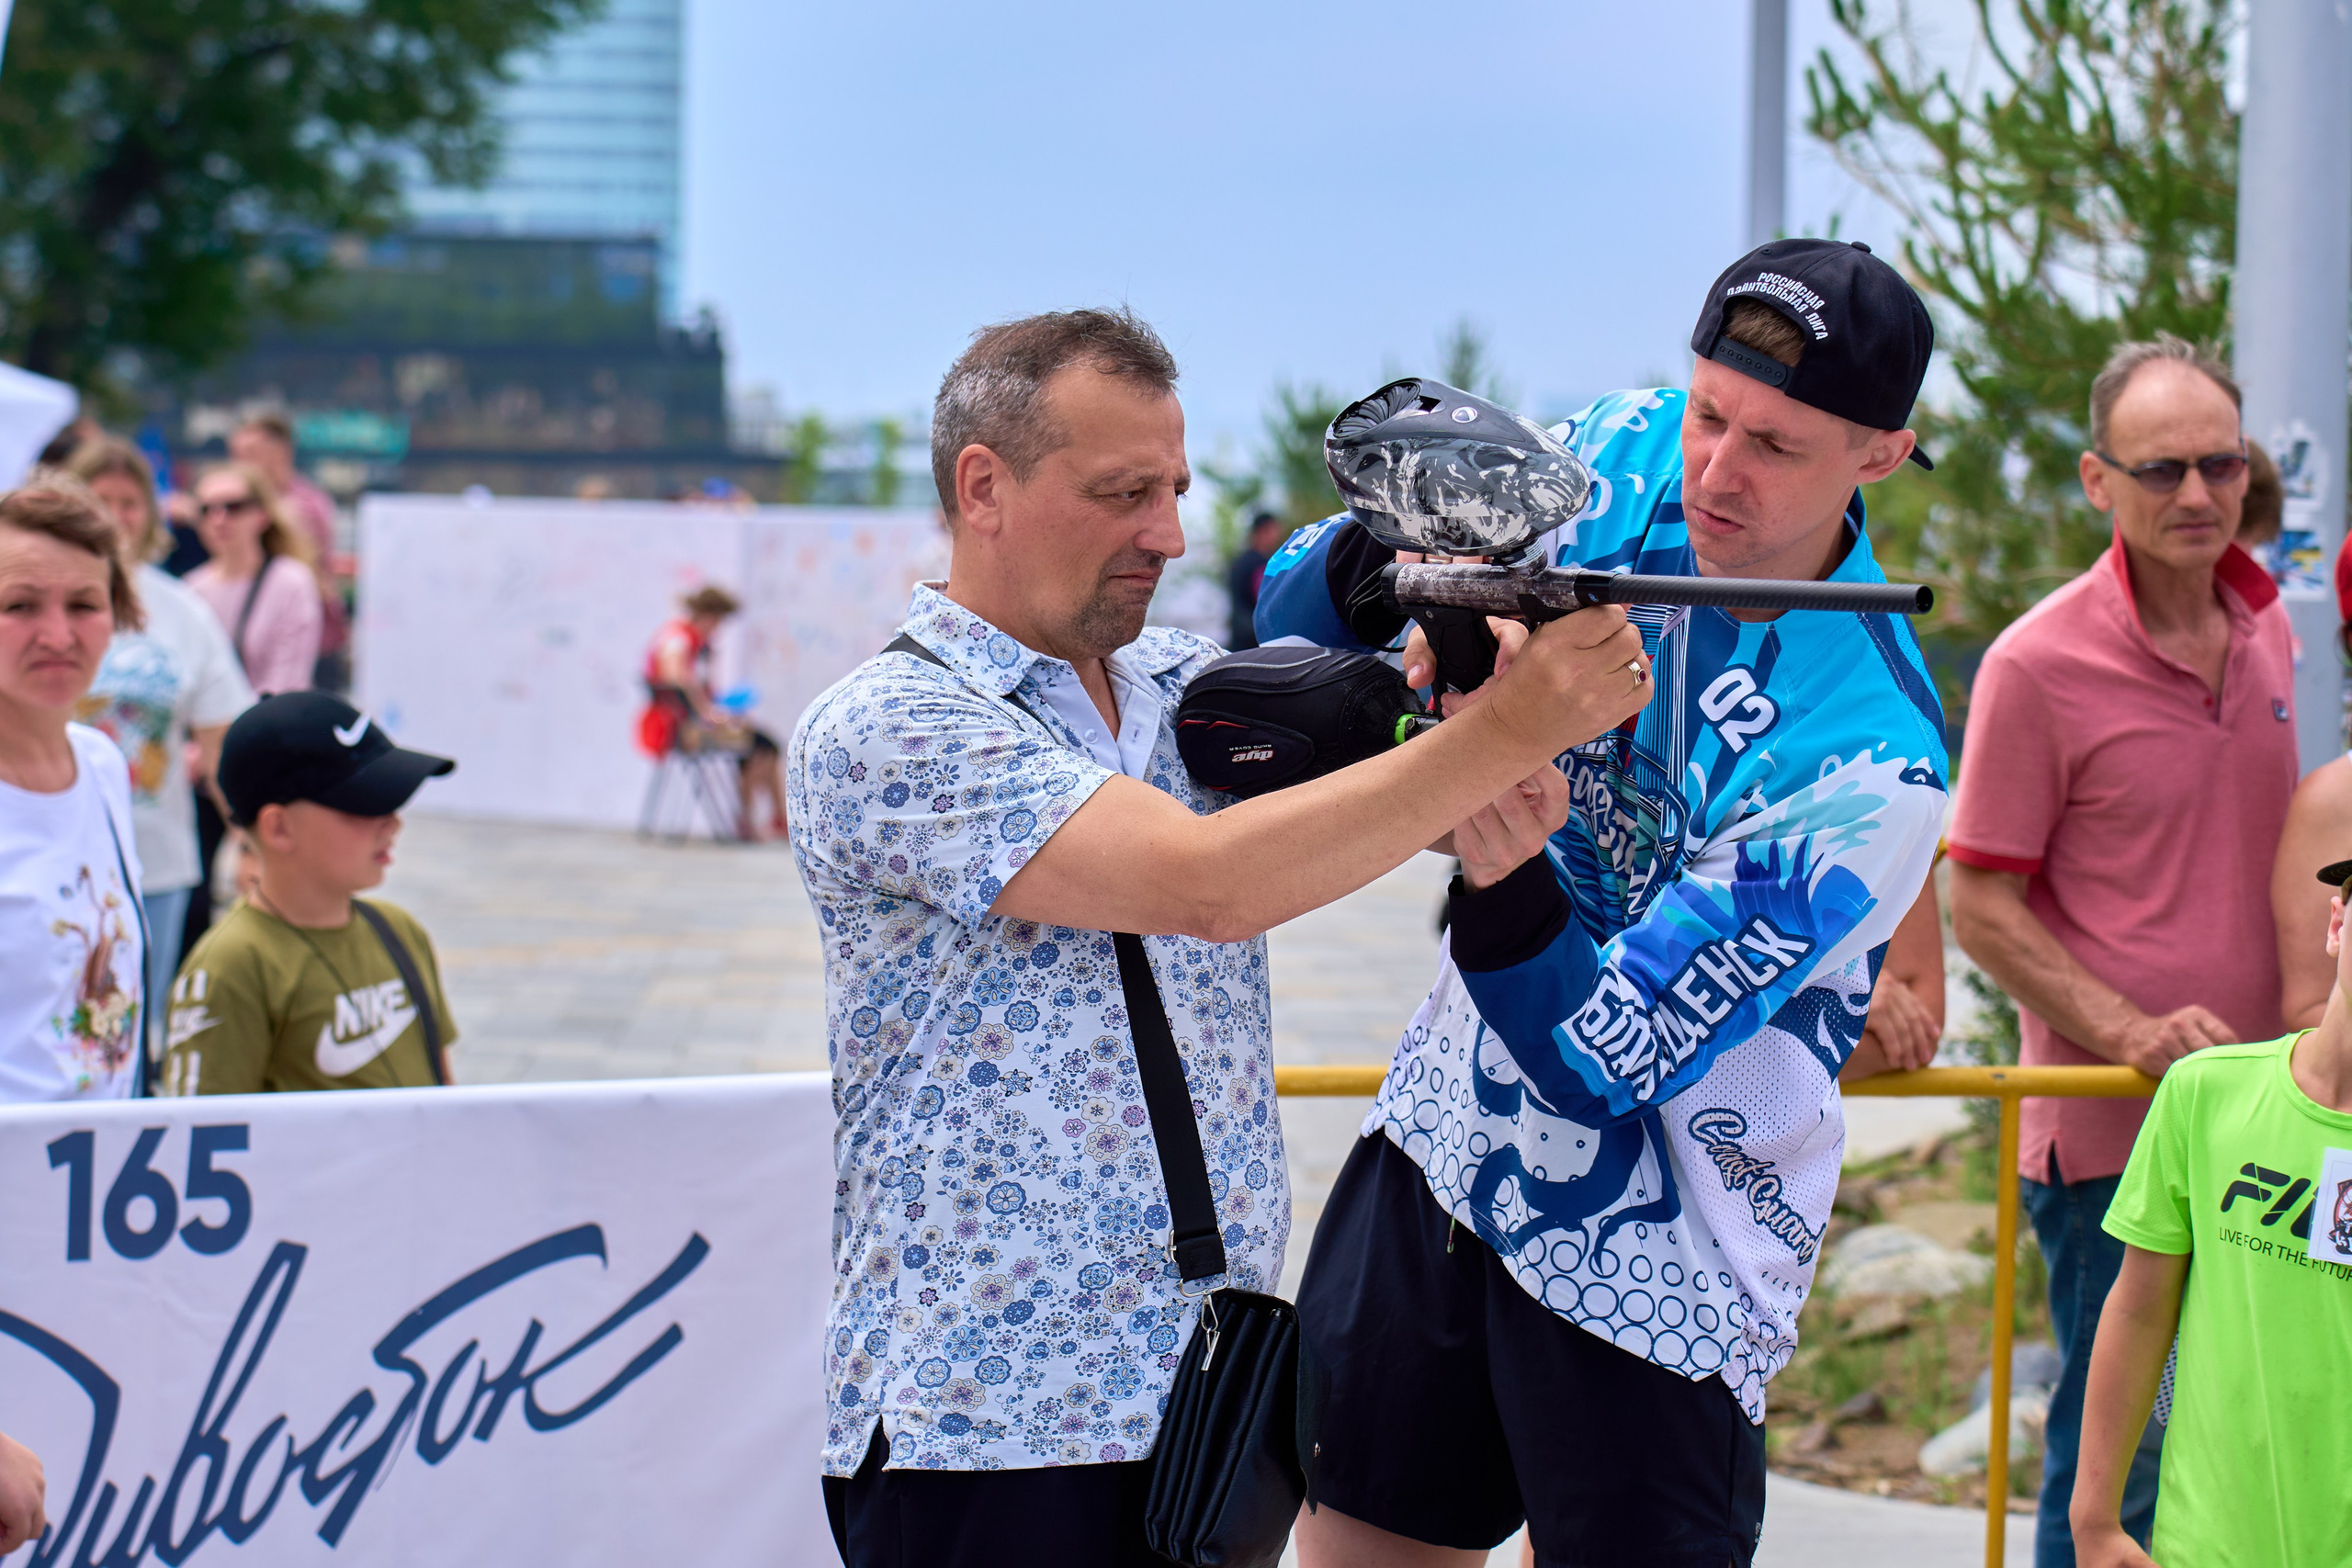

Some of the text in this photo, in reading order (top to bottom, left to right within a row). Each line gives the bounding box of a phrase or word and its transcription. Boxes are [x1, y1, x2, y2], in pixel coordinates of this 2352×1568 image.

[1757, 272, 1826, 310] РОССИЙСКАЯ
[1805, 312, 1829, 341] ЛИГА
[1698, 668, 1775, 753] 02
[334, 977, 407, 1040] NIKE
[47, 1122, 253, 1263] 165
[1688, 1108, 1826, 1266] Coast Guard
[2219, 1226, 2243, 1247] LIVE
[2244, 1234, 2274, 1257] FOR
[2277, 1245, 2308, 1267] THE
